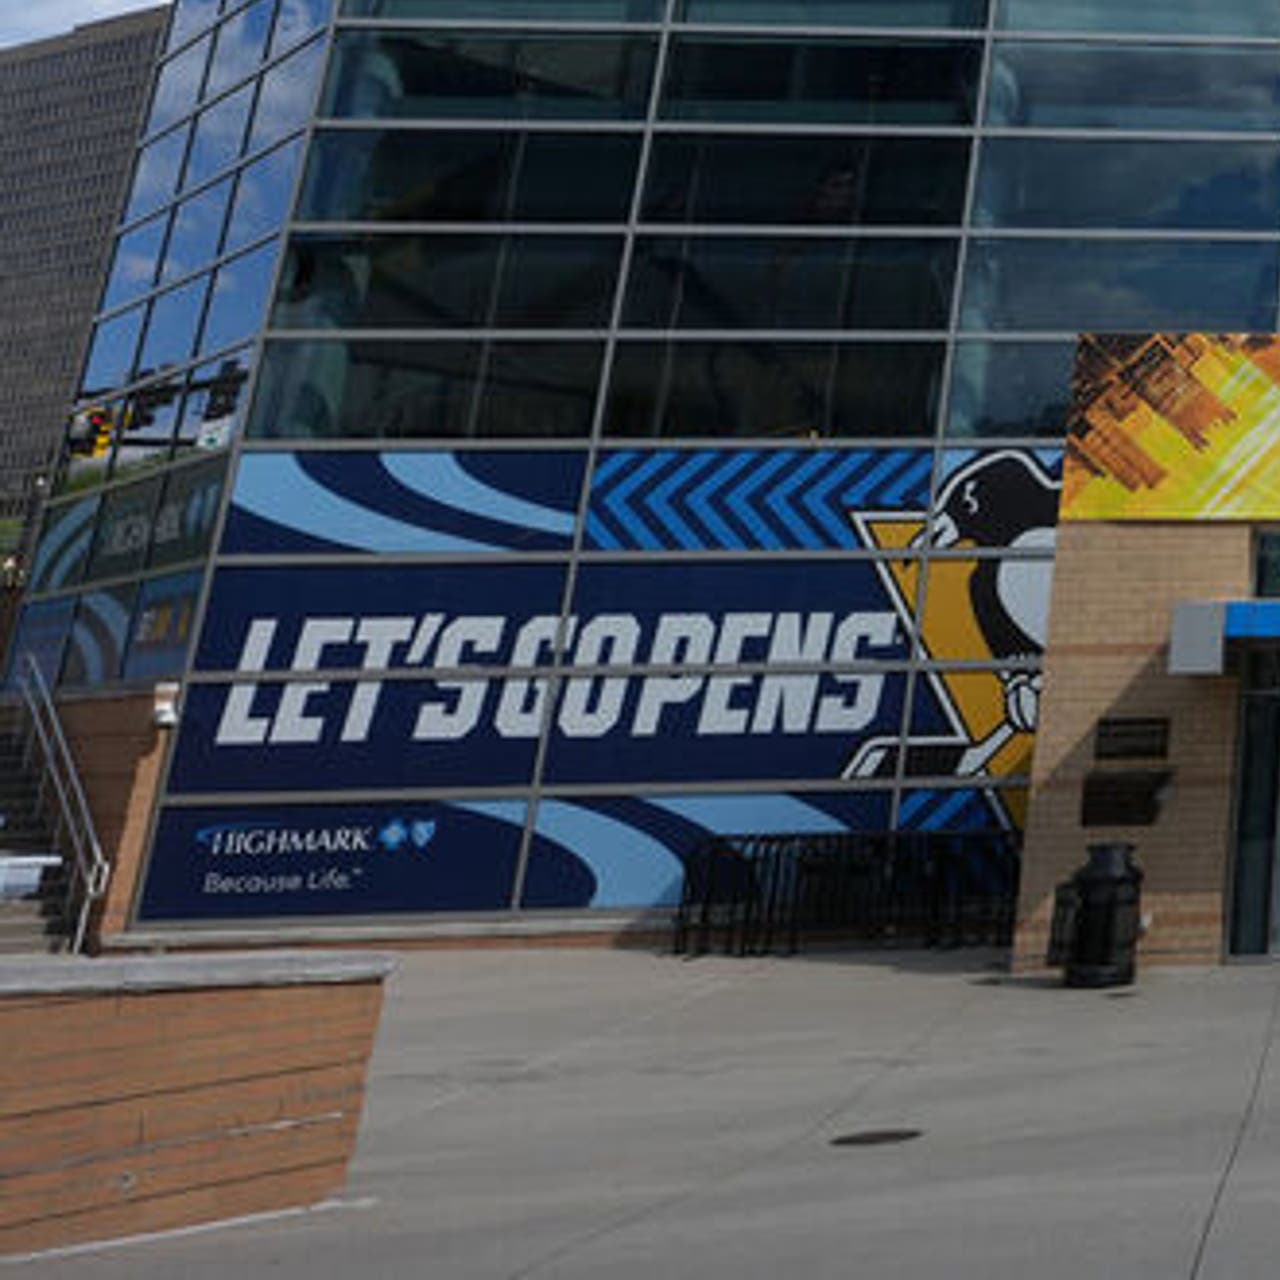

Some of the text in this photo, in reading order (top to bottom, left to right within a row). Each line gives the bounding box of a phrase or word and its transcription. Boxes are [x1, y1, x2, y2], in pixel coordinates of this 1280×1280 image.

[213, 611, 898, 745] LET'S GO PENS
[206, 825, 373, 855] HIGHMARK
[203, 871, 302, 894] Because
